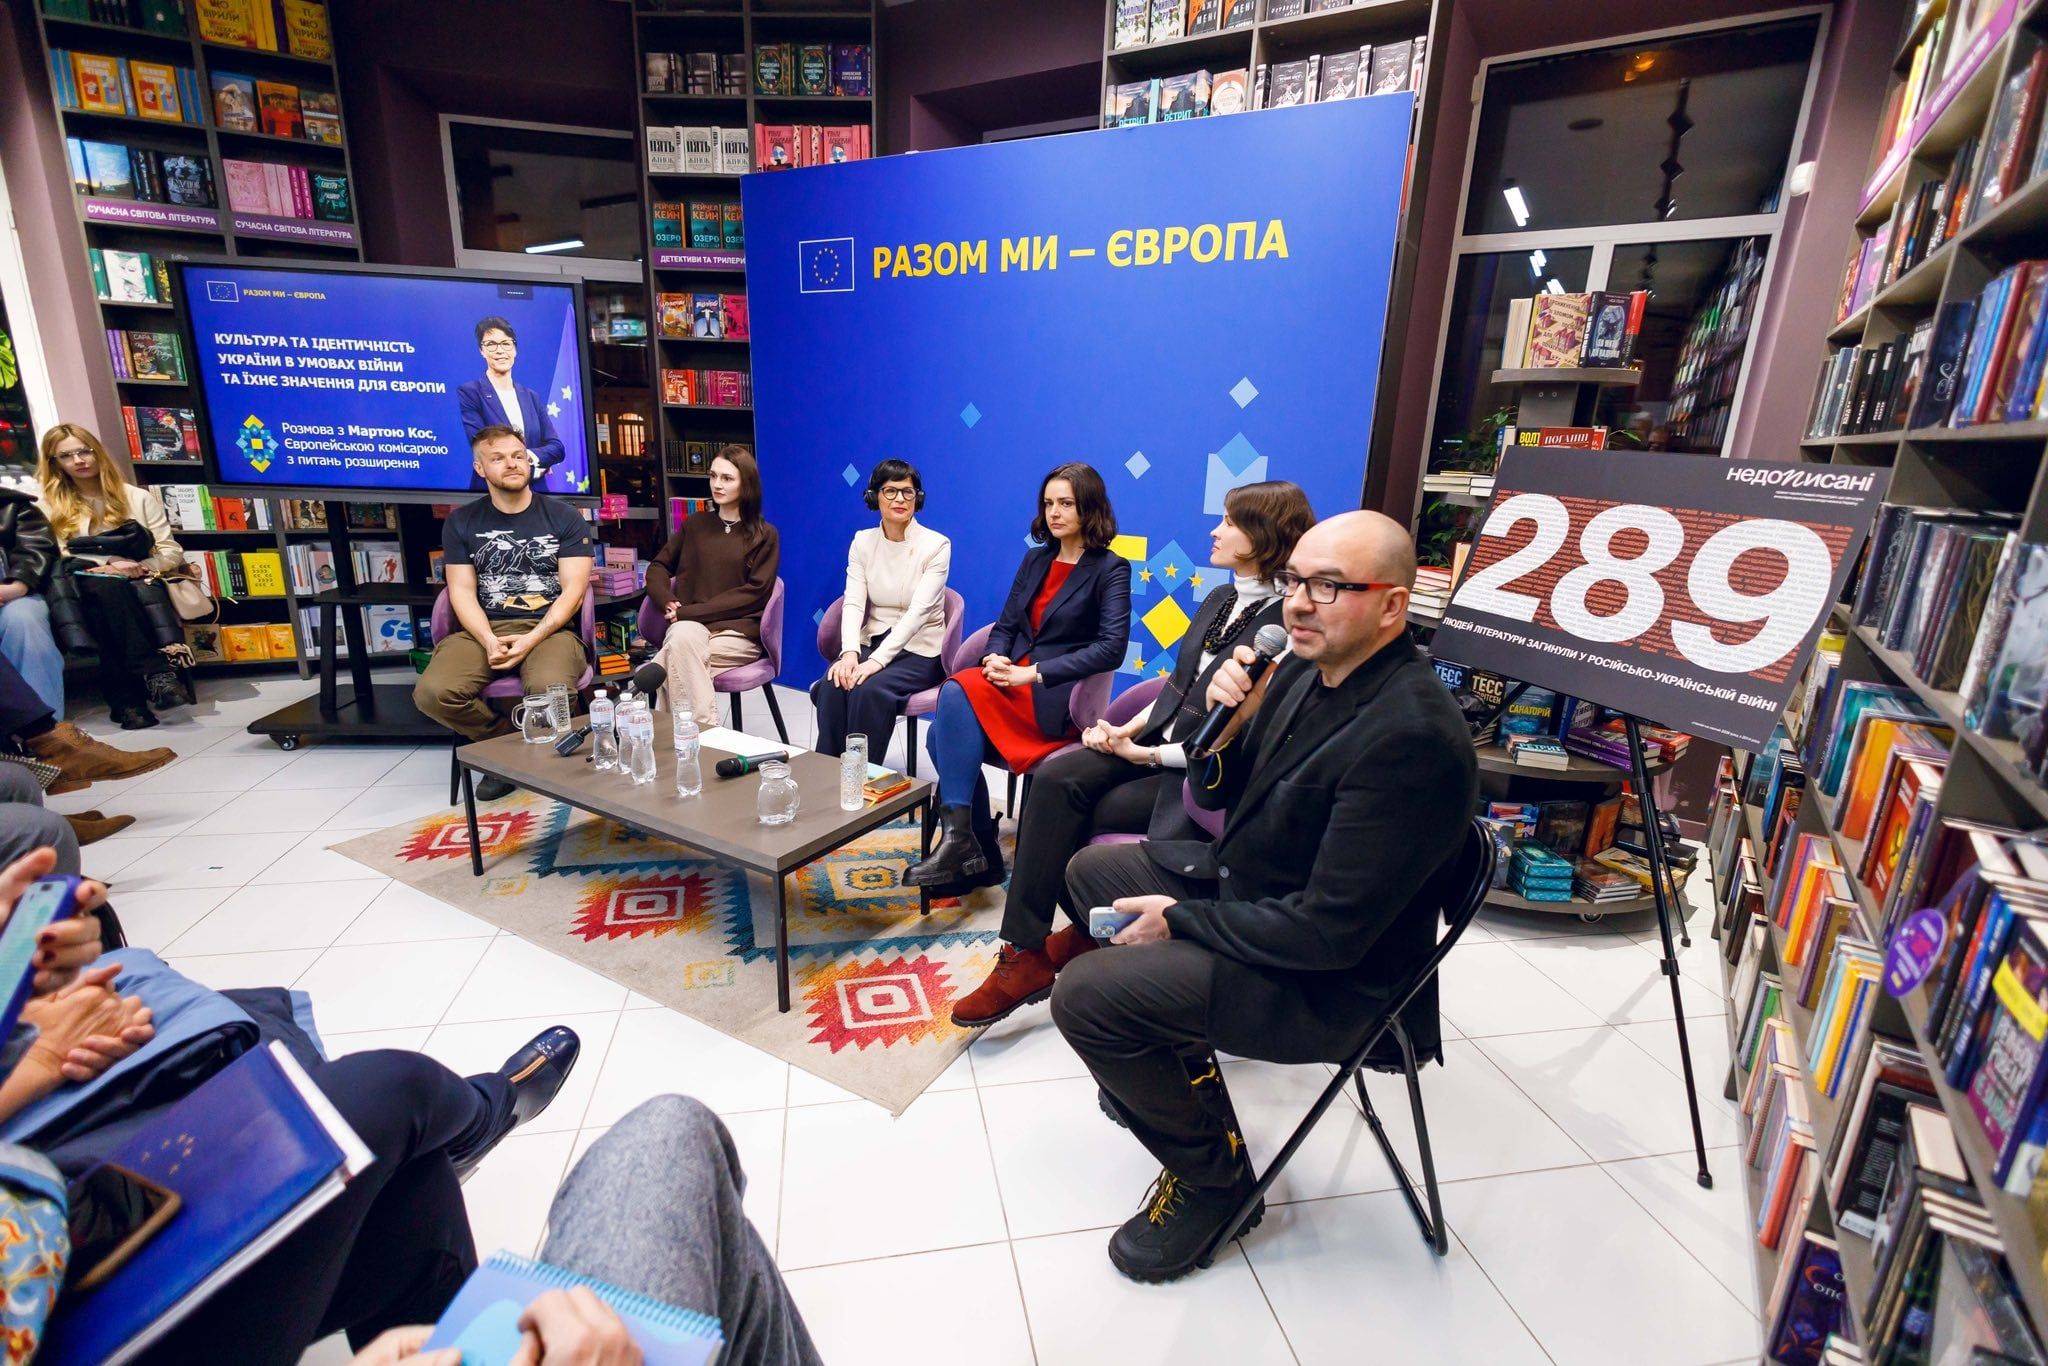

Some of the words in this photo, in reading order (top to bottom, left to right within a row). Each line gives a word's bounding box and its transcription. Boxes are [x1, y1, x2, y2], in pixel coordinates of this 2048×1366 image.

[86, 204, 129, 218] СУЧАСНА
[130, 209, 167, 221] СВІТОВА
[168, 213, 217, 227] ЛІТЕРАТУРА
[235, 220, 273, 233] СУЧАСНА
[274, 223, 308, 236] СВІТОВА
[308, 228, 353, 241] ЛІТЕРАТУРА
[660, 255, 702, 263] ДЕТЕКТИВИ
[873, 240, 988, 279] РАЗОМ
[1000, 235, 1059, 273] МИ
[1106, 219, 1290, 268] ЄВРОПА
[243, 288, 271, 298] РАЗОМ
[272, 290, 285, 298] МИ
[293, 291, 326, 300] ЄВРОПА
[214, 333, 288, 349] КУЛЬТУРА
[290, 336, 309, 349] ТА
[311, 338, 416, 354] ІДЕНТИЧНІСТЬ
[218, 350, 282, 368] УКРАЇНИ
[285, 355, 295, 368] В
[297, 356, 356, 371] УМОВАХ
[358, 357, 404, 373] ВІЙНИ
[221, 372, 241, 385] ТА
[242, 370, 279, 387] ЇХНЄ
[281, 374, 355, 390] ЗНАЧЕННЯ
[357, 378, 388, 393] ДЛЯ
[390, 379, 447, 394] ЄВРОПИ
[281, 421, 336, 438] Розмова
[337, 427, 345, 436] з
[347, 424, 405, 439] Мартою
[407, 425, 437, 441] Кос,
[284, 437, 375, 455] Європейською
[378, 440, 449, 458] комісаркою
[287, 455, 294, 465] з
[296, 455, 342, 468] питань
[344, 457, 420, 471] розширення
[1726, 467, 1876, 492] недописані
[1452, 493, 1832, 673] 289
[1441, 616, 1474, 633] ЛЮДЕЙ
[1473, 625, 1527, 646] ЛІТЕРАТУРИ
[1526, 638, 1578, 660] ЗАГИНУЛИ
[1577, 651, 1588, 662] У
[1586, 652, 1737, 702] РОСІЙСЬКО-УКРАЇНСЬКІЙ
[1737, 691, 1779, 713] ВІЙНІ
[1472, 675, 1504, 696] ТЕСС
[1508, 704, 1551, 718] САНАТОРІЙ
